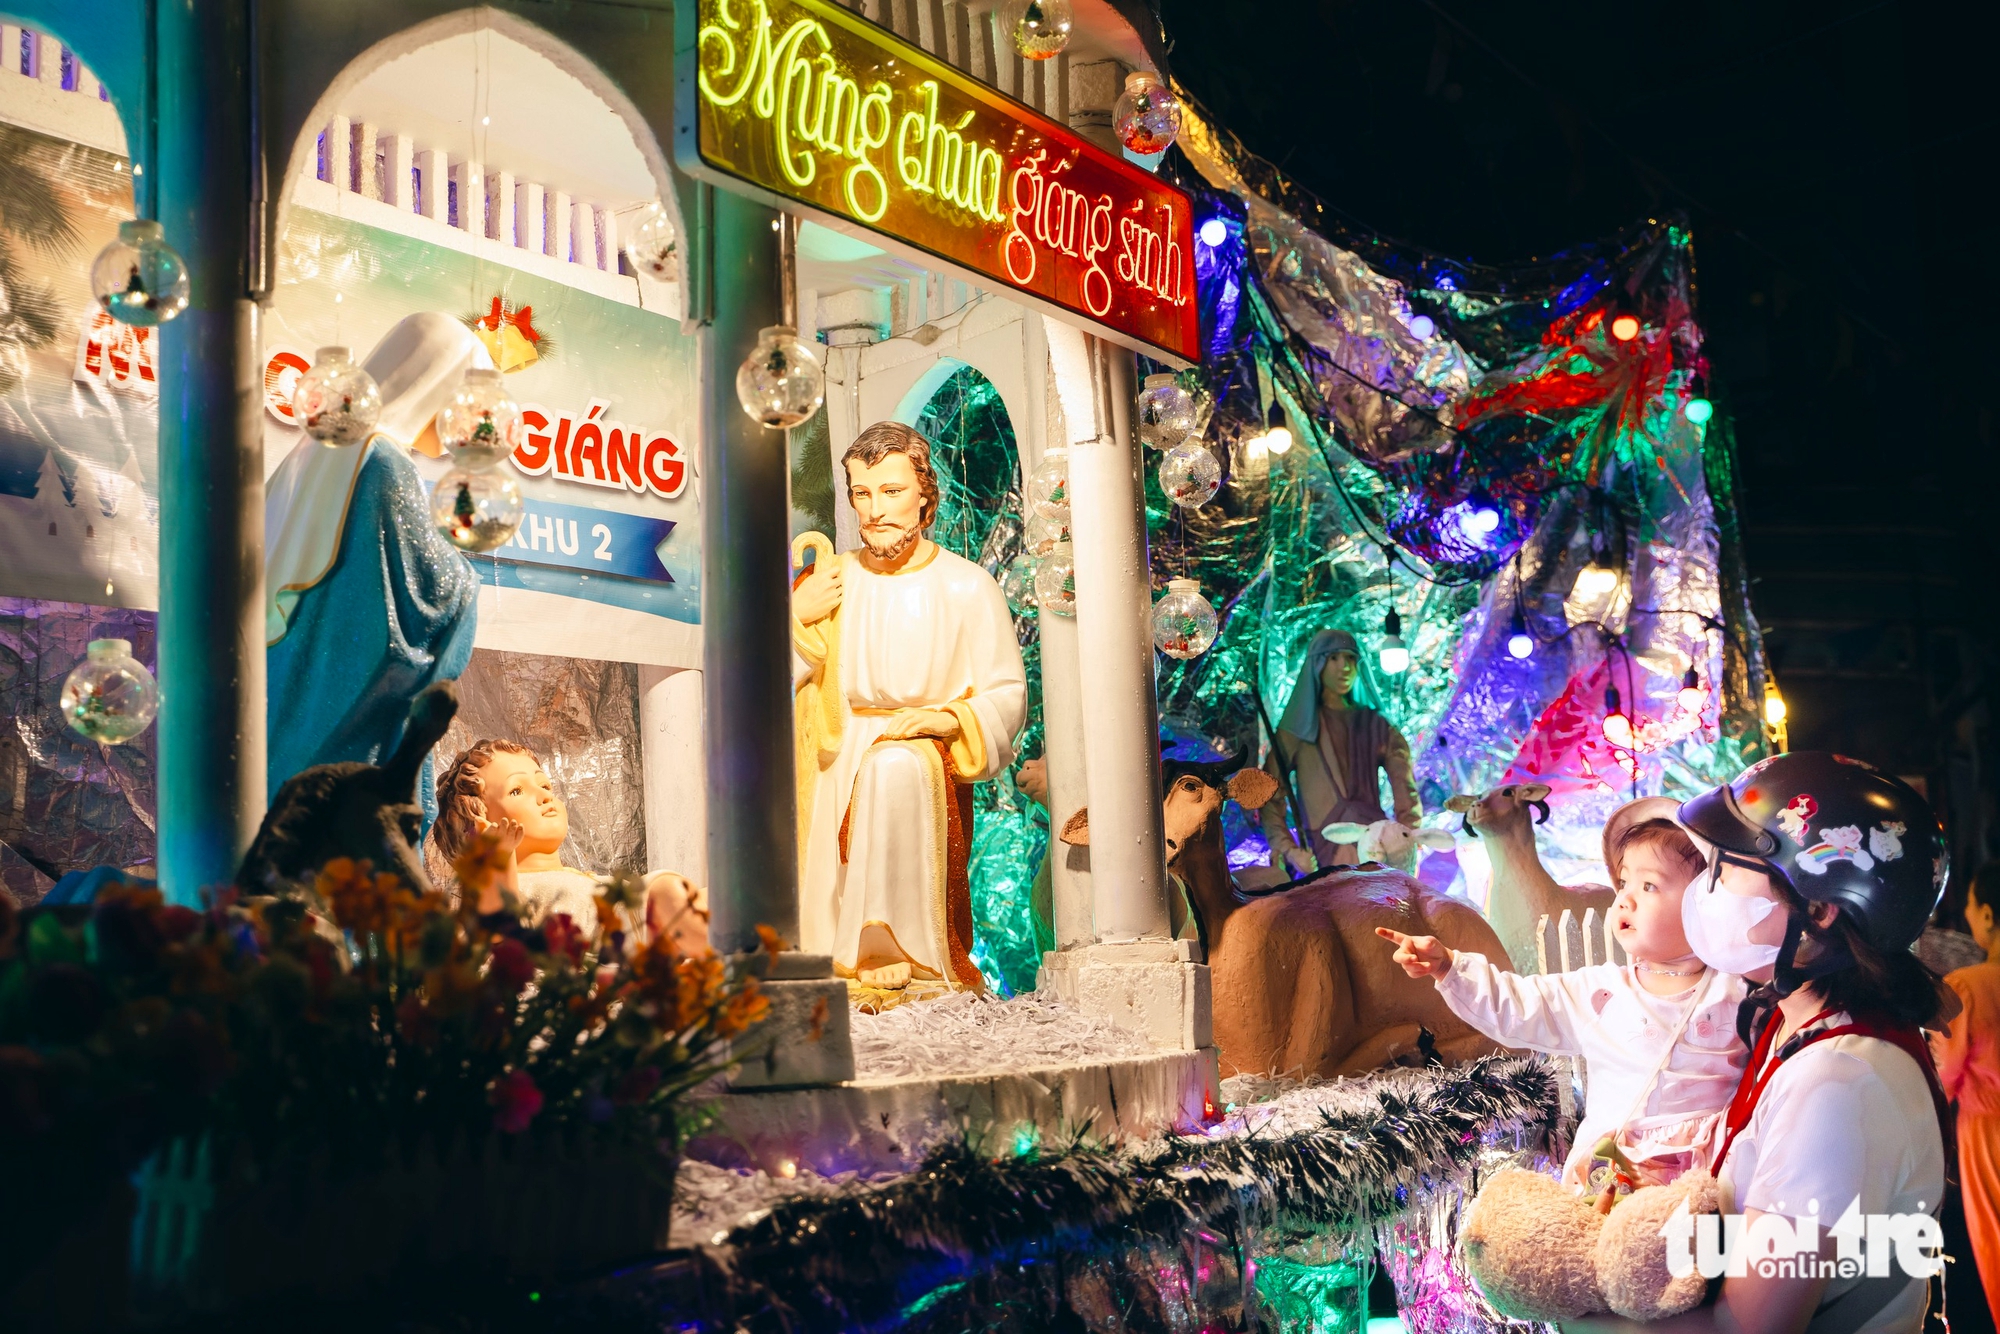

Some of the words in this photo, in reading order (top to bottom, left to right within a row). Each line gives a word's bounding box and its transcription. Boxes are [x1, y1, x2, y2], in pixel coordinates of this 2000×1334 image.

[698, 0, 893, 223] Mừng
[899, 79, 1006, 223] chúa
[1004, 148, 1113, 317] giáng
[1117, 198, 1187, 307] sinh
[512, 404, 685, 494] GIÁNG
[591, 522, 613, 561] 2
